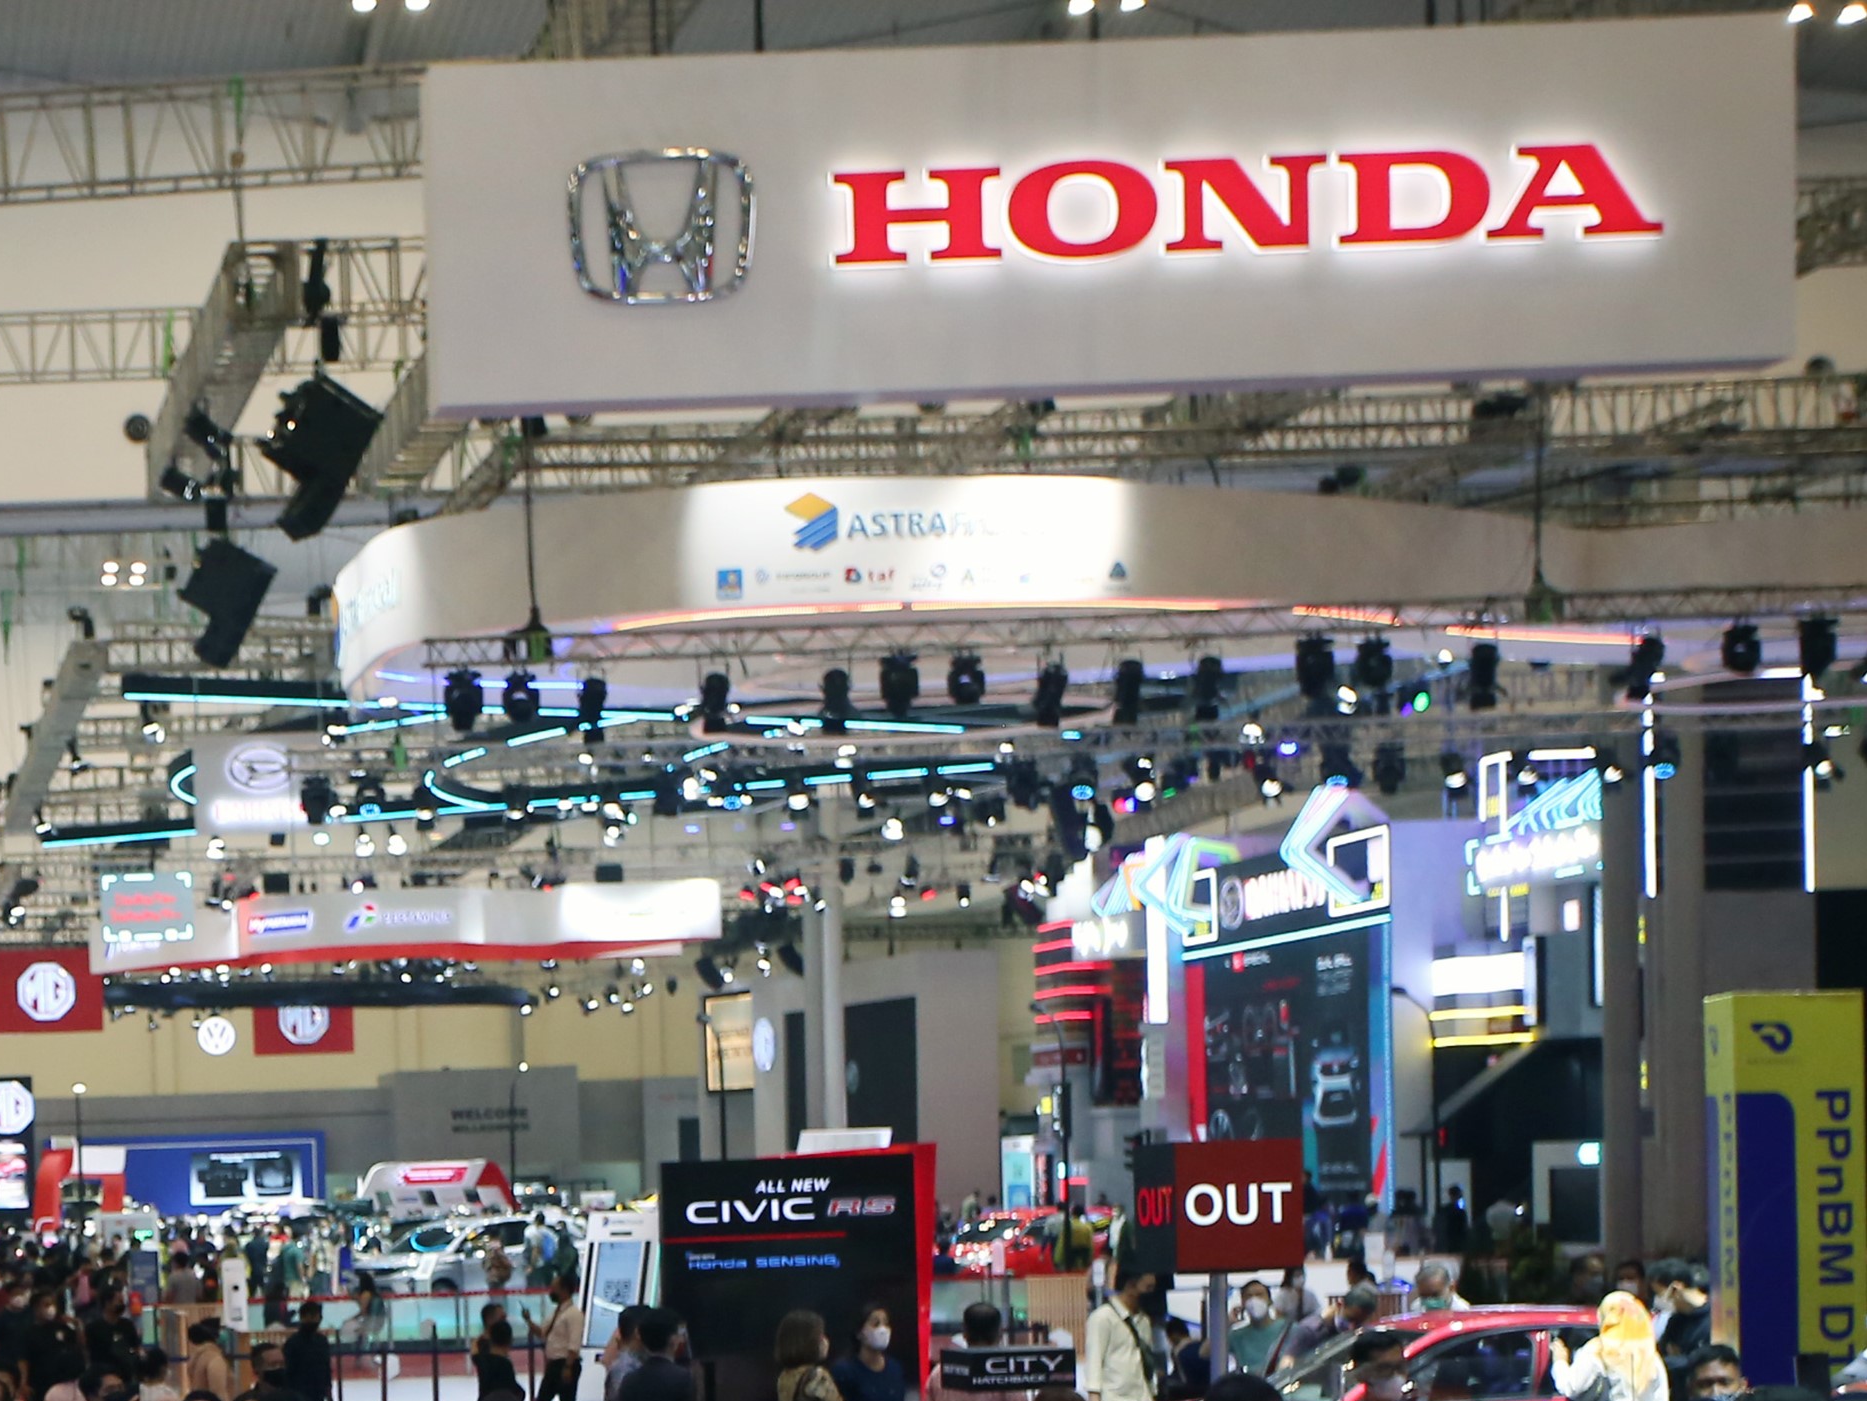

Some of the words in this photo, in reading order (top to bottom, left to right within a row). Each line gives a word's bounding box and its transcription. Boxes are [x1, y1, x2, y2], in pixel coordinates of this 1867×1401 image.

[833, 143, 1664, 265] HONDA
[755, 1179, 786, 1194] ALL
[791, 1176, 831, 1193] NEW
[1814, 1090, 1855, 1287] PPnBM
[685, 1197, 816, 1225] CIVIC
[827, 1195, 897, 1218] RS
[1137, 1185, 1173, 1227] OUT
[1184, 1182, 1293, 1227] OUT
[688, 1257, 748, 1270] Honda
[755, 1254, 840, 1268] SENSING
[984, 1354, 1064, 1374] CITY
[972, 1374, 1046, 1386] HATCHBACK
